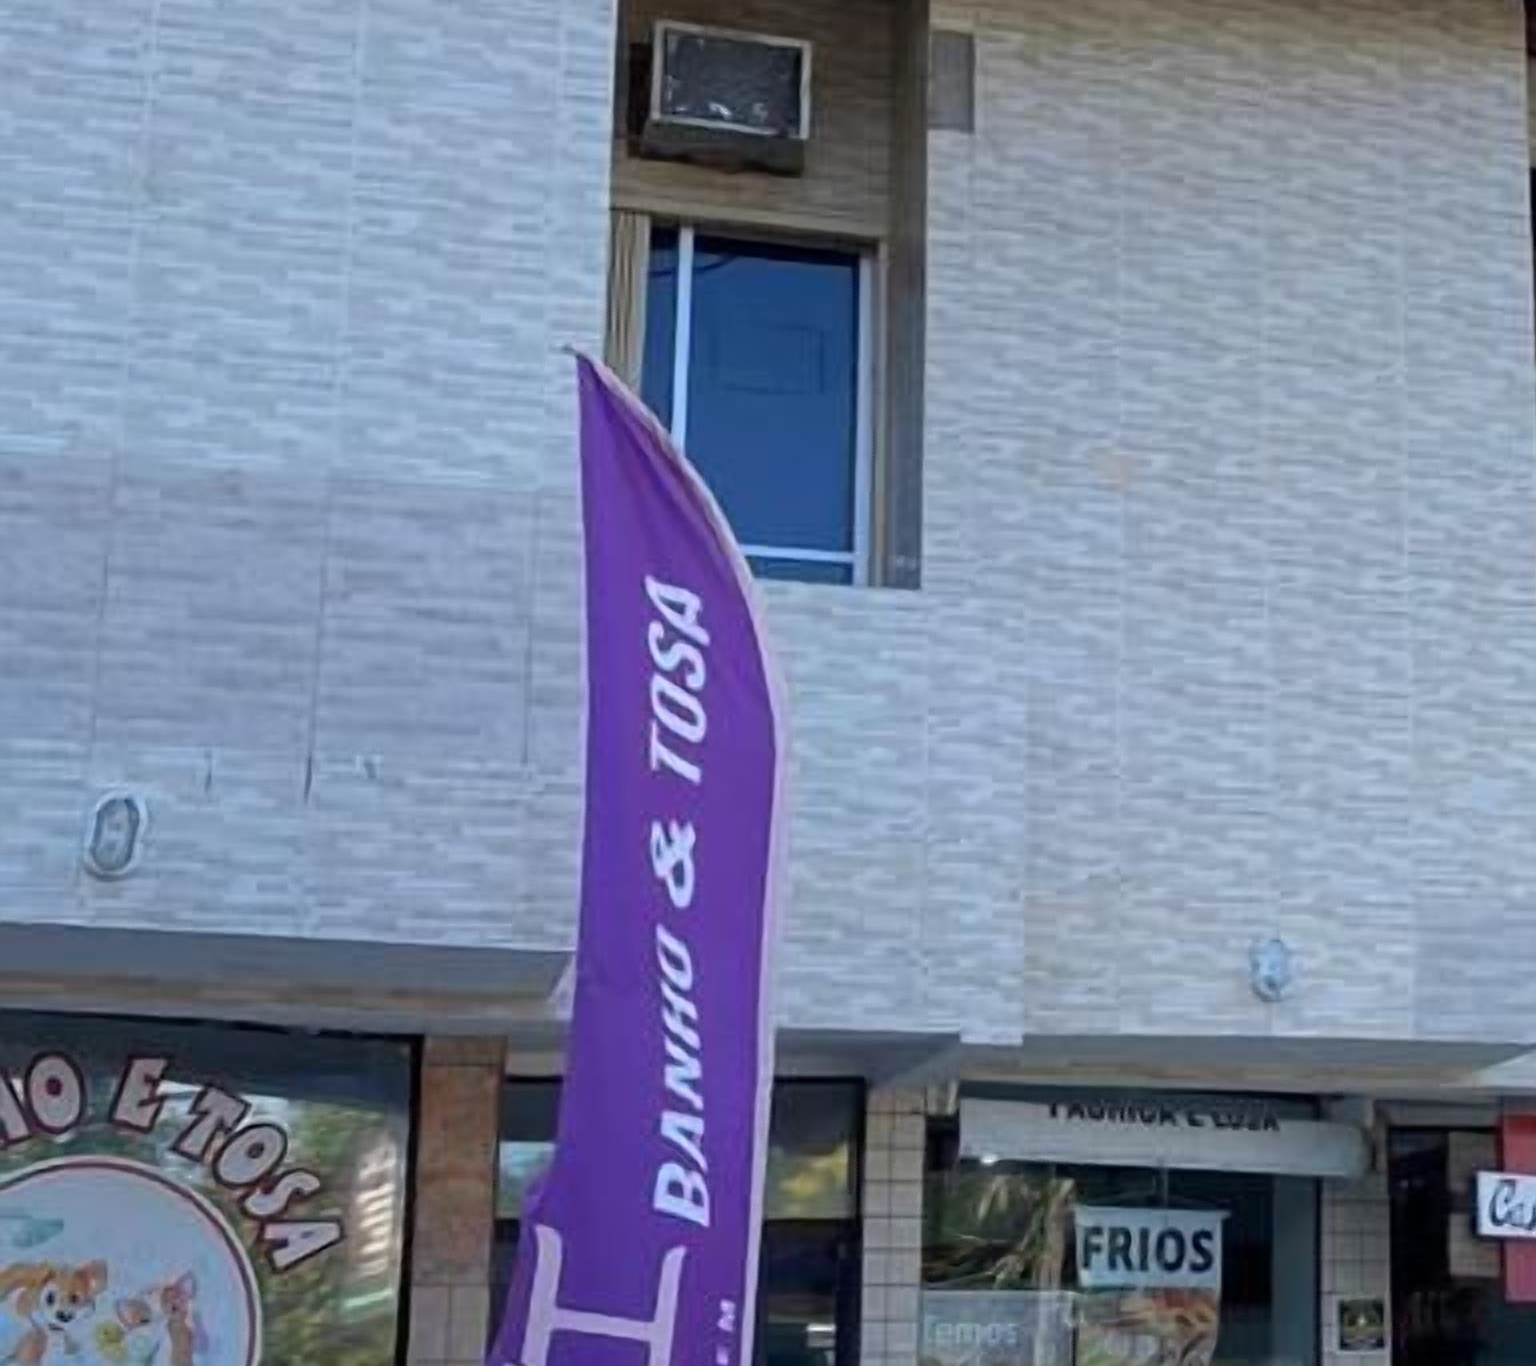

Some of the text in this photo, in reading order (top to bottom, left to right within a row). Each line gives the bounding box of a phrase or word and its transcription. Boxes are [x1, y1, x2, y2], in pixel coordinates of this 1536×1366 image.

[644, 574, 712, 1228] BANHO & TOSA
[109, 1054, 173, 1132] E
[168, 1083, 347, 1274] TOSA
[1081, 1225, 1215, 1274] FRIOS
